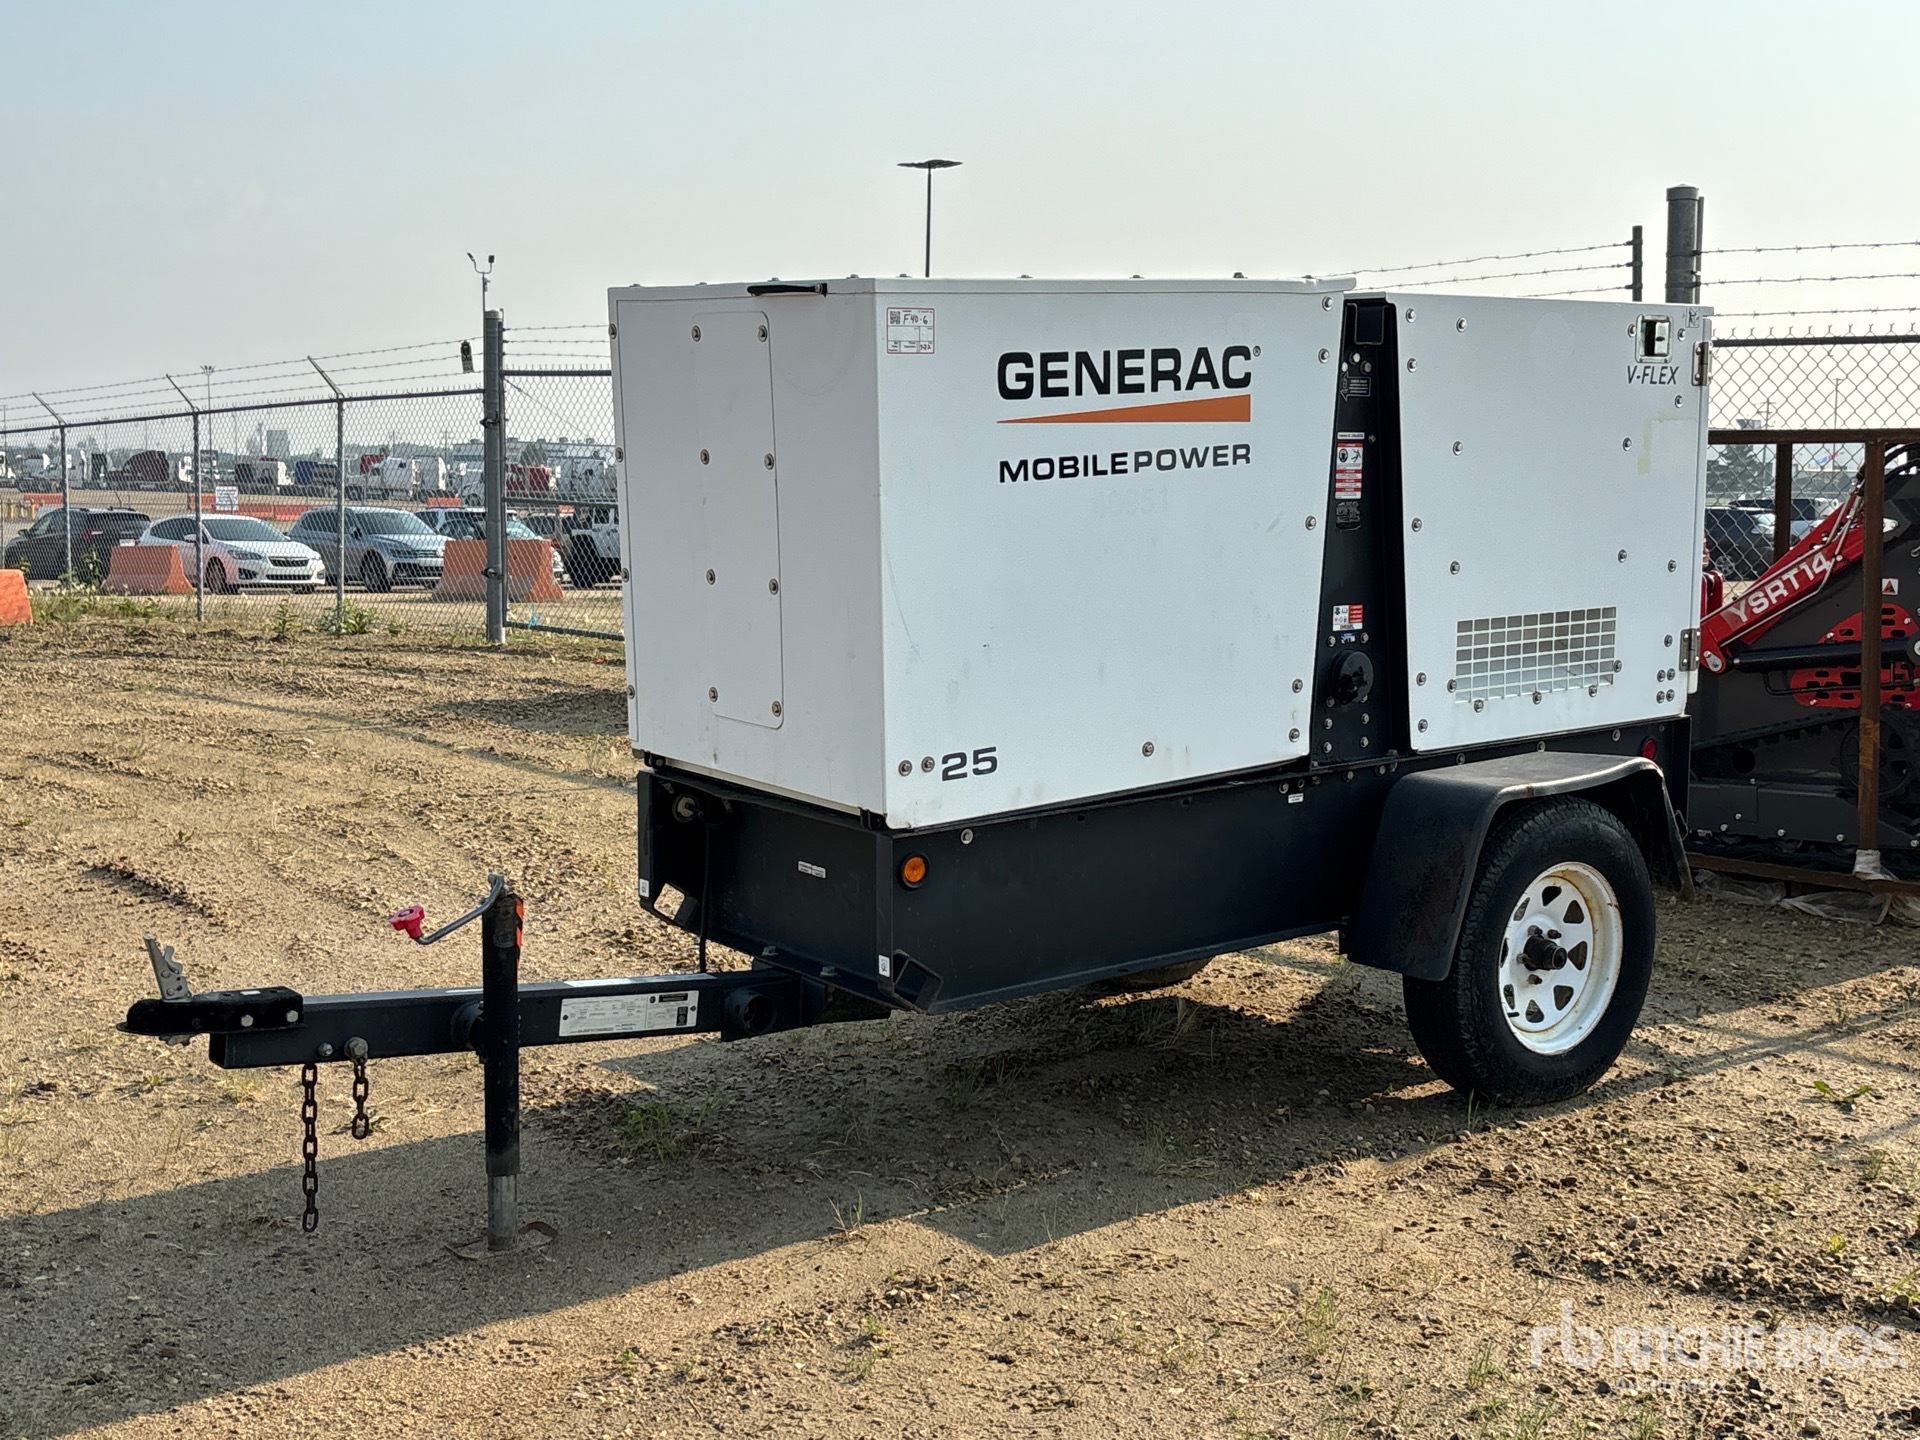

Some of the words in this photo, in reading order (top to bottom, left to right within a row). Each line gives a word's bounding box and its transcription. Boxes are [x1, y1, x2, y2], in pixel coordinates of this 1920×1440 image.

[1627, 365, 1679, 385] V-FLEX
[999, 443, 1251, 484] MOBILEPOWER
[1729, 552, 1832, 624] YSRT14
[941, 746, 998, 782] 25
